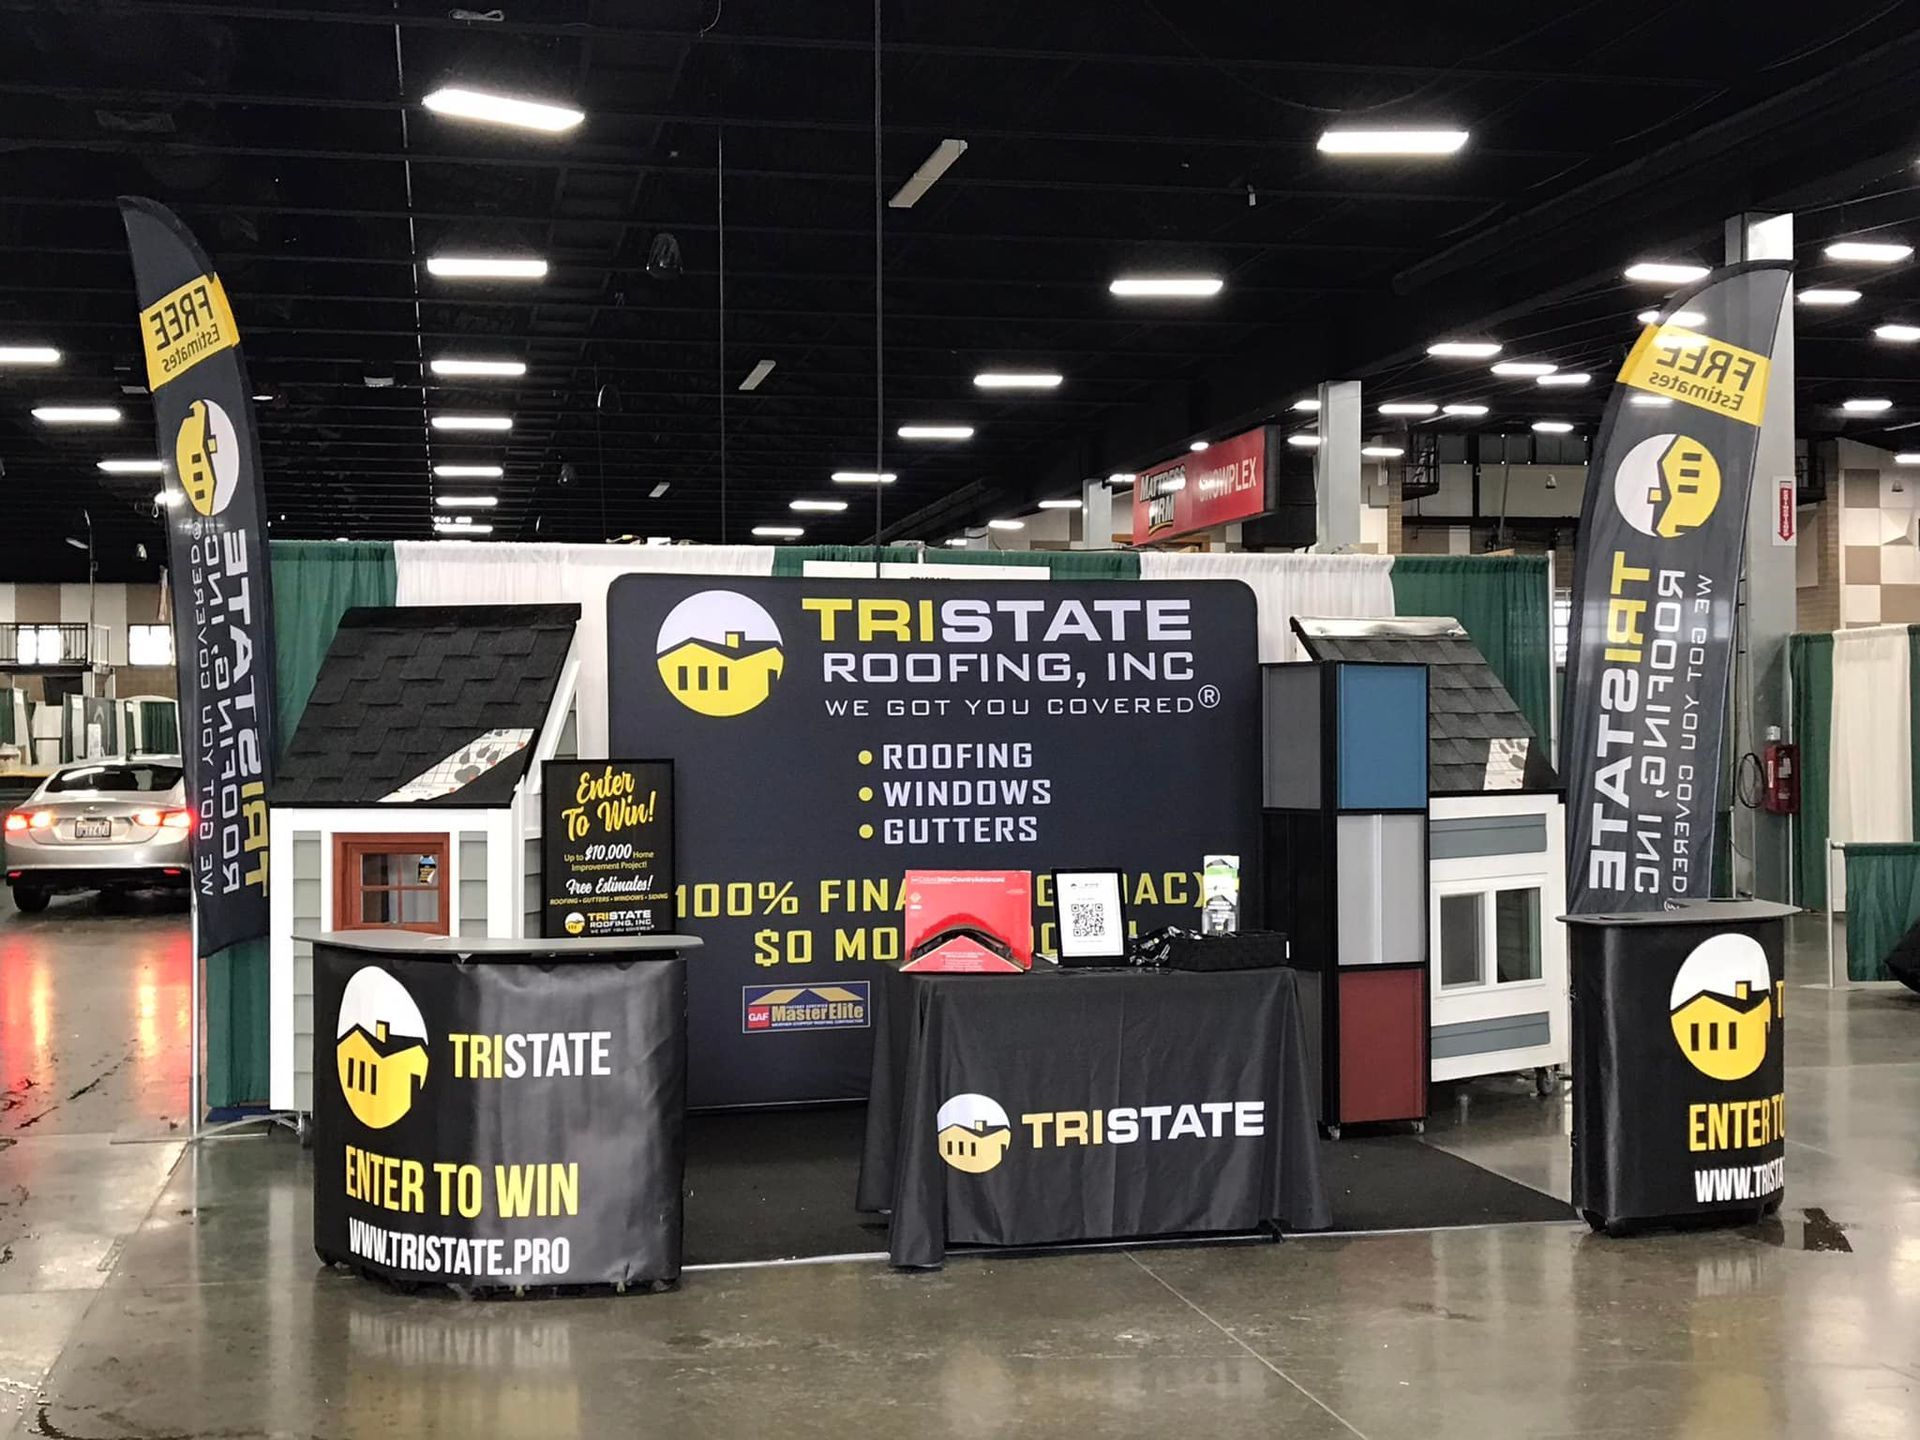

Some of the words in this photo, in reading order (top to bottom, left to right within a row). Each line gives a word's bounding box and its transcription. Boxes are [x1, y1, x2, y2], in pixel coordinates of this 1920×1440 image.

[801, 597, 1193, 643] TRISTATE
[823, 652, 1087, 688] ROOFING,
[1108, 650, 1195, 682] INC
[824, 699, 869, 717] WE
[887, 699, 951, 717] GOT
[964, 699, 1030, 717] YOU
[882, 742, 1033, 770] ROOFING
[576, 765, 635, 805] Enter
[883, 779, 1052, 808] WINDOWS
[561, 806, 591, 842] To
[597, 790, 657, 832] Win!
[883, 816, 1038, 845] GUTTERS
[563, 853, 576, 862] Up
[576, 854, 585, 862] to
[585, 843, 632, 861] $10,000
[633, 851, 654, 859] Home
[571, 862, 620, 872] Improvement
[565, 878, 592, 895] Free
[595, 875, 654, 894] Estimates!
[675, 881, 799, 918] 100%
[587, 909, 652, 921] TRISTATE
[635, 918, 652, 926] INC
[754, 928, 813, 967] $0
[748, 1011, 769, 1022] GAF
[449, 1031, 612, 1079] TRISTATE
[1021, 1101, 1265, 1149] TRISTATE
[1689, 1098, 1771, 1152] ENTER
[346, 1144, 425, 1216] ENTER
[433, 1162, 483, 1219] TO
[494, 1162, 579, 1218] WIN
[349, 1216, 571, 1276] WWW.TRISTATE.PRO
